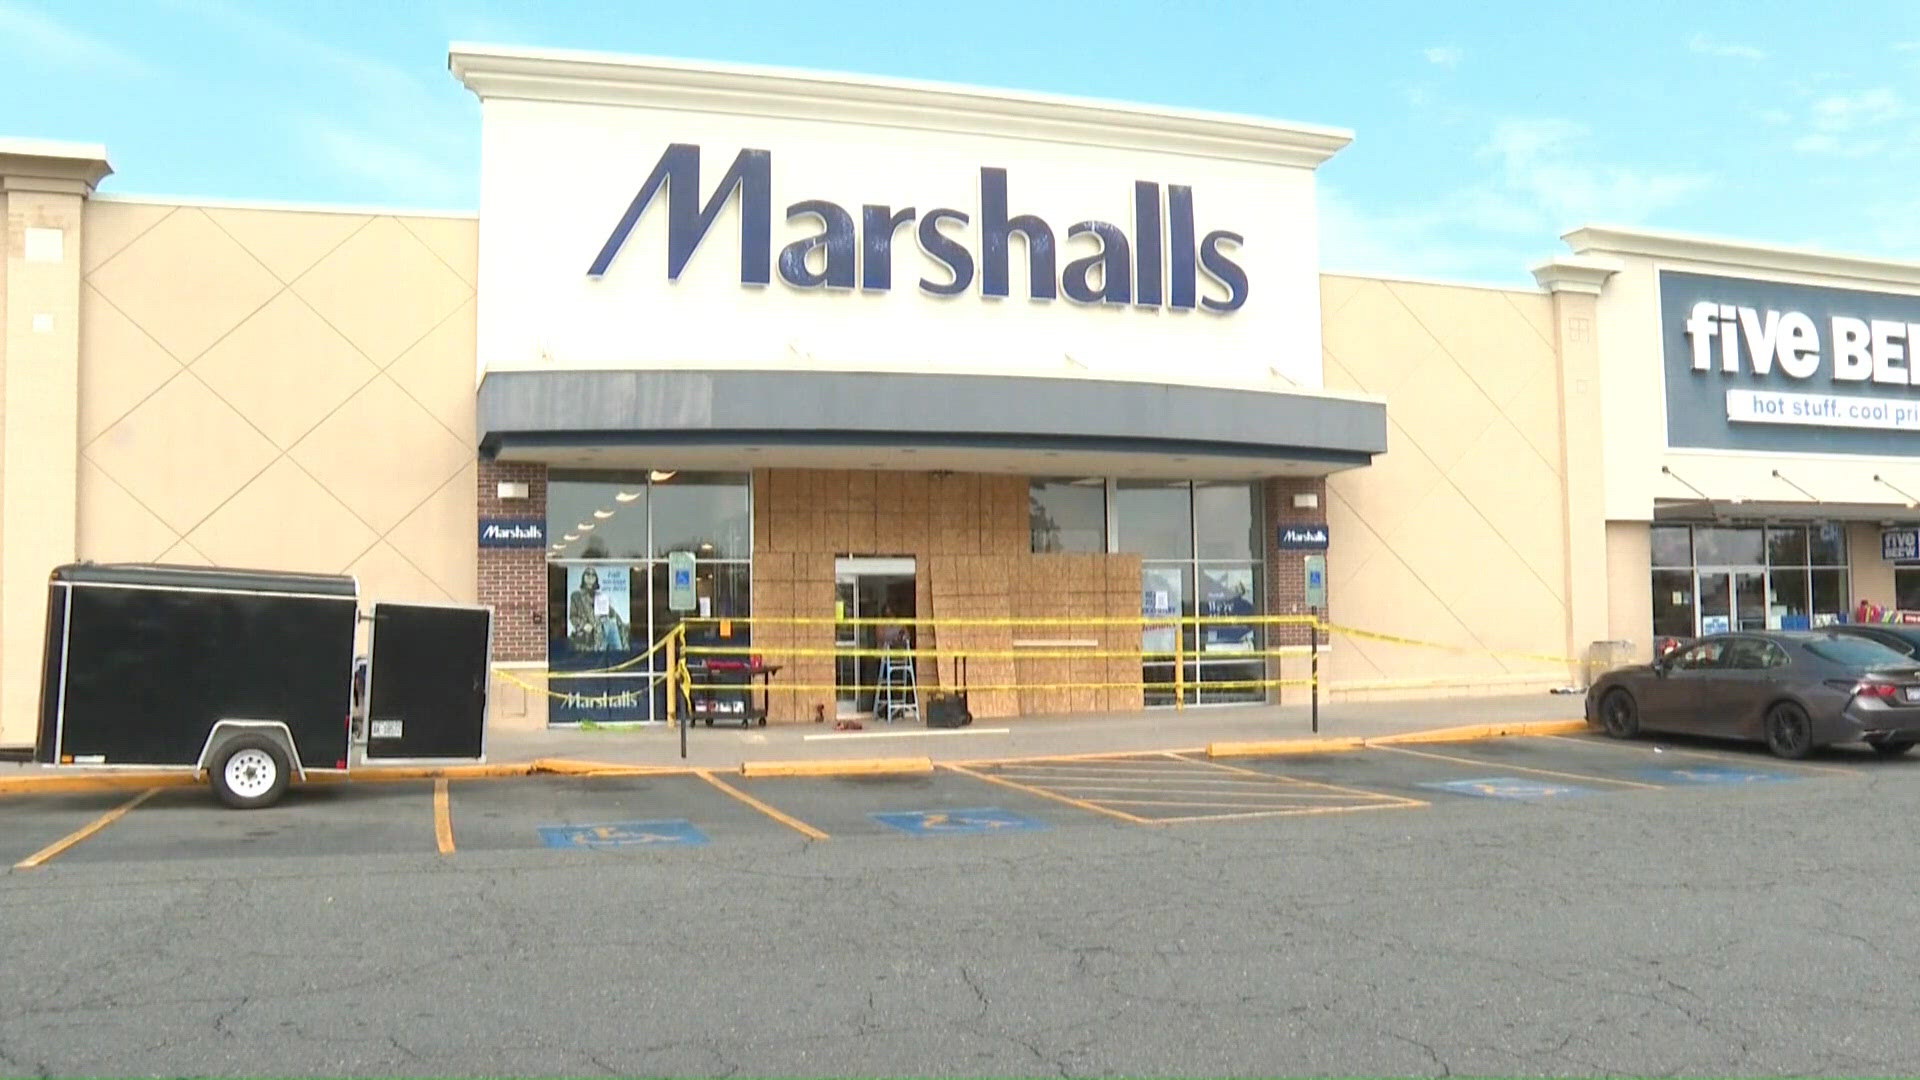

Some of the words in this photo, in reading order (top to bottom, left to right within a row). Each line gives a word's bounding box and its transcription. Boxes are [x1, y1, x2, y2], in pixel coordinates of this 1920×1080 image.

[586, 142, 1249, 313] Marshalls
[1686, 301, 1820, 379] five
[1753, 395, 1784, 415] hot
[1793, 399, 1841, 418] stuff.
[1849, 403, 1888, 420] cool
[1895, 404, 1919, 425] pri
[482, 525, 543, 539] Marshalls
[1283, 530, 1327, 543] Marshalls
[560, 690, 638, 709] Marshalls
